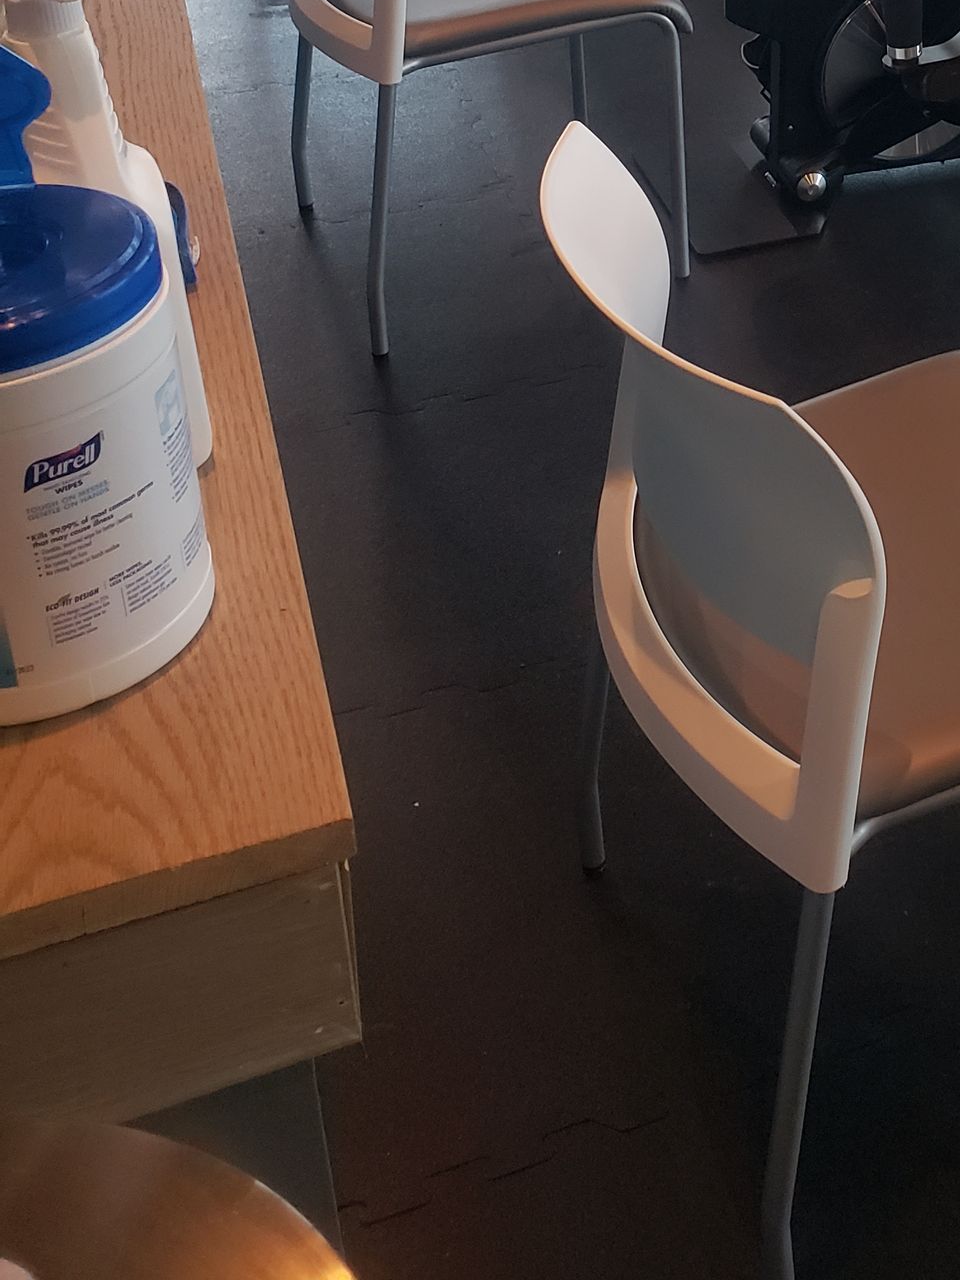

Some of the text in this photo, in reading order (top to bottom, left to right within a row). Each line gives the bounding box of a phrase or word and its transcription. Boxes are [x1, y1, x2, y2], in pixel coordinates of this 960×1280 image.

[32, 443, 96, 483] Purell
[54, 479, 83, 494] WIPES
[61, 495, 76, 504] ON
[63, 501, 78, 510] ON
[31, 532, 48, 541] Kills
[49, 521, 79, 535] 99.99%
[81, 516, 89, 524] of
[90, 508, 107, 520] most
[109, 493, 136, 512] common
[136, 481, 154, 497] germs
[33, 539, 49, 549] that
[50, 534, 68, 543] may
[70, 525, 91, 536] cause
[93, 514, 114, 527] illness
[75, 587, 99, 603] DESIGN
